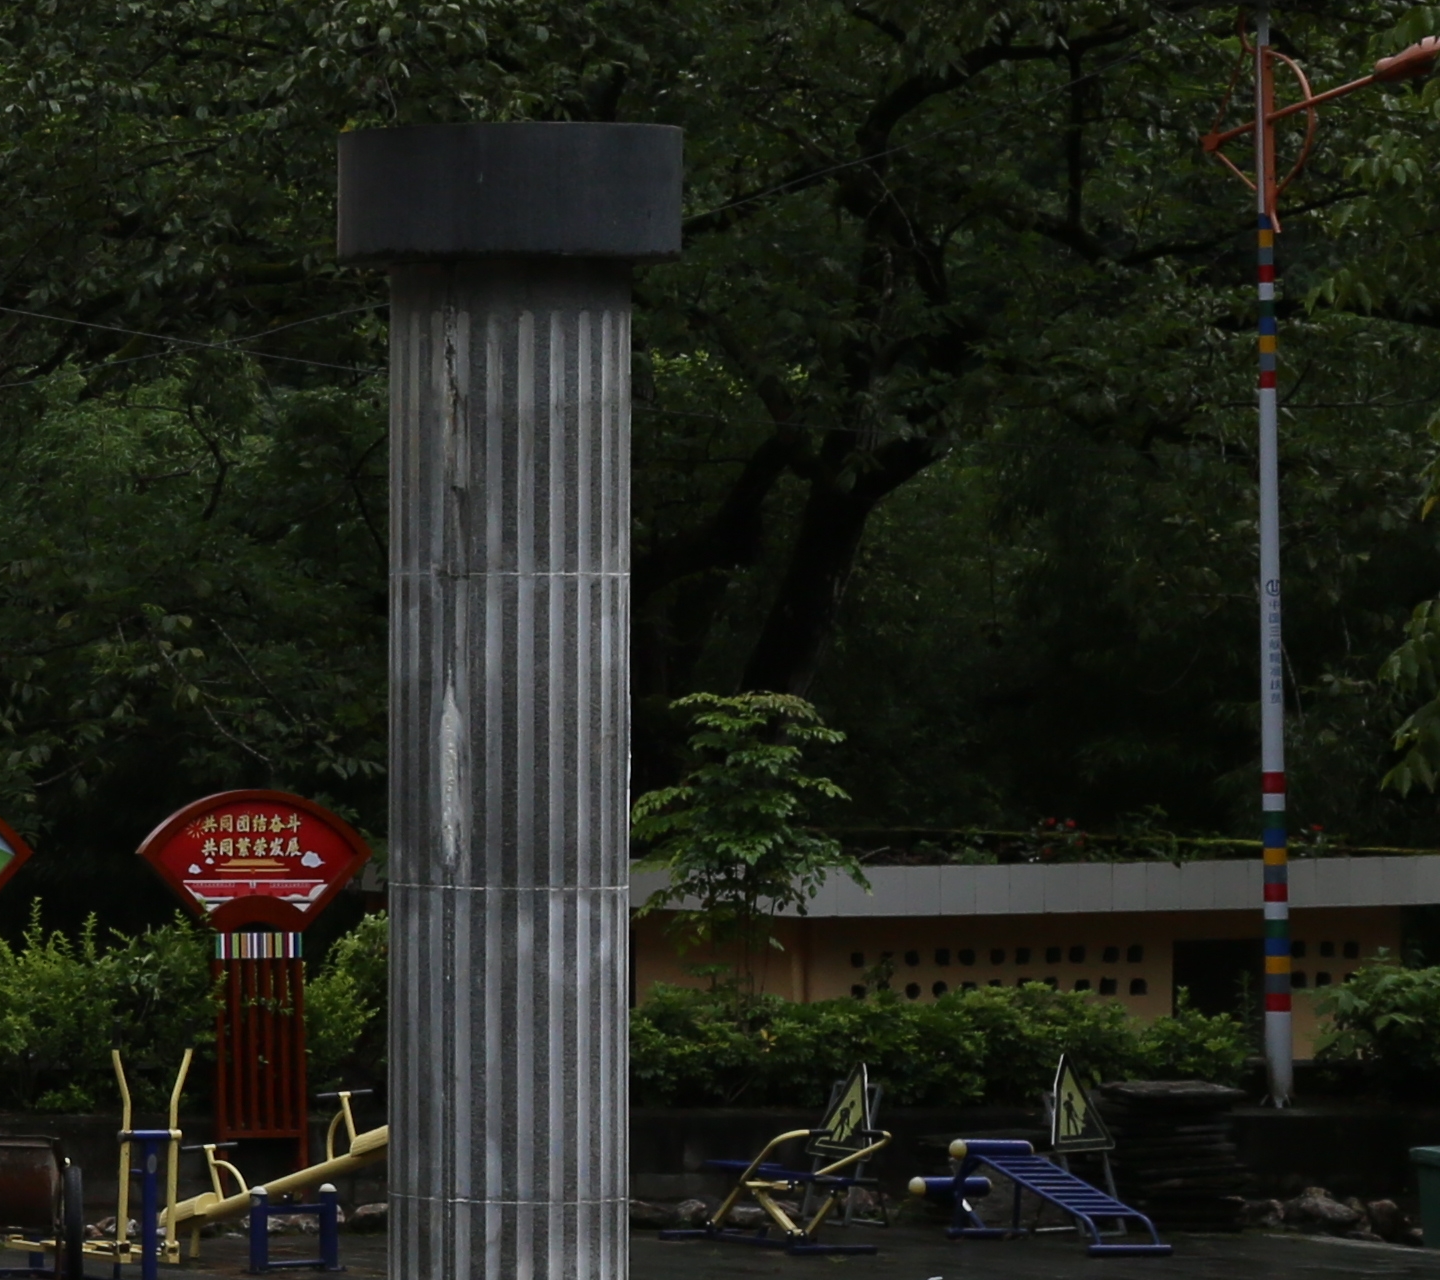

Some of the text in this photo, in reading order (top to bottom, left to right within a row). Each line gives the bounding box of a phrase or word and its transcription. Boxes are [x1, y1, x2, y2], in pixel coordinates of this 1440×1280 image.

[202, 813, 301, 833] 共同团结奋斗
[201, 837, 302, 857] 共同繁荣发展
